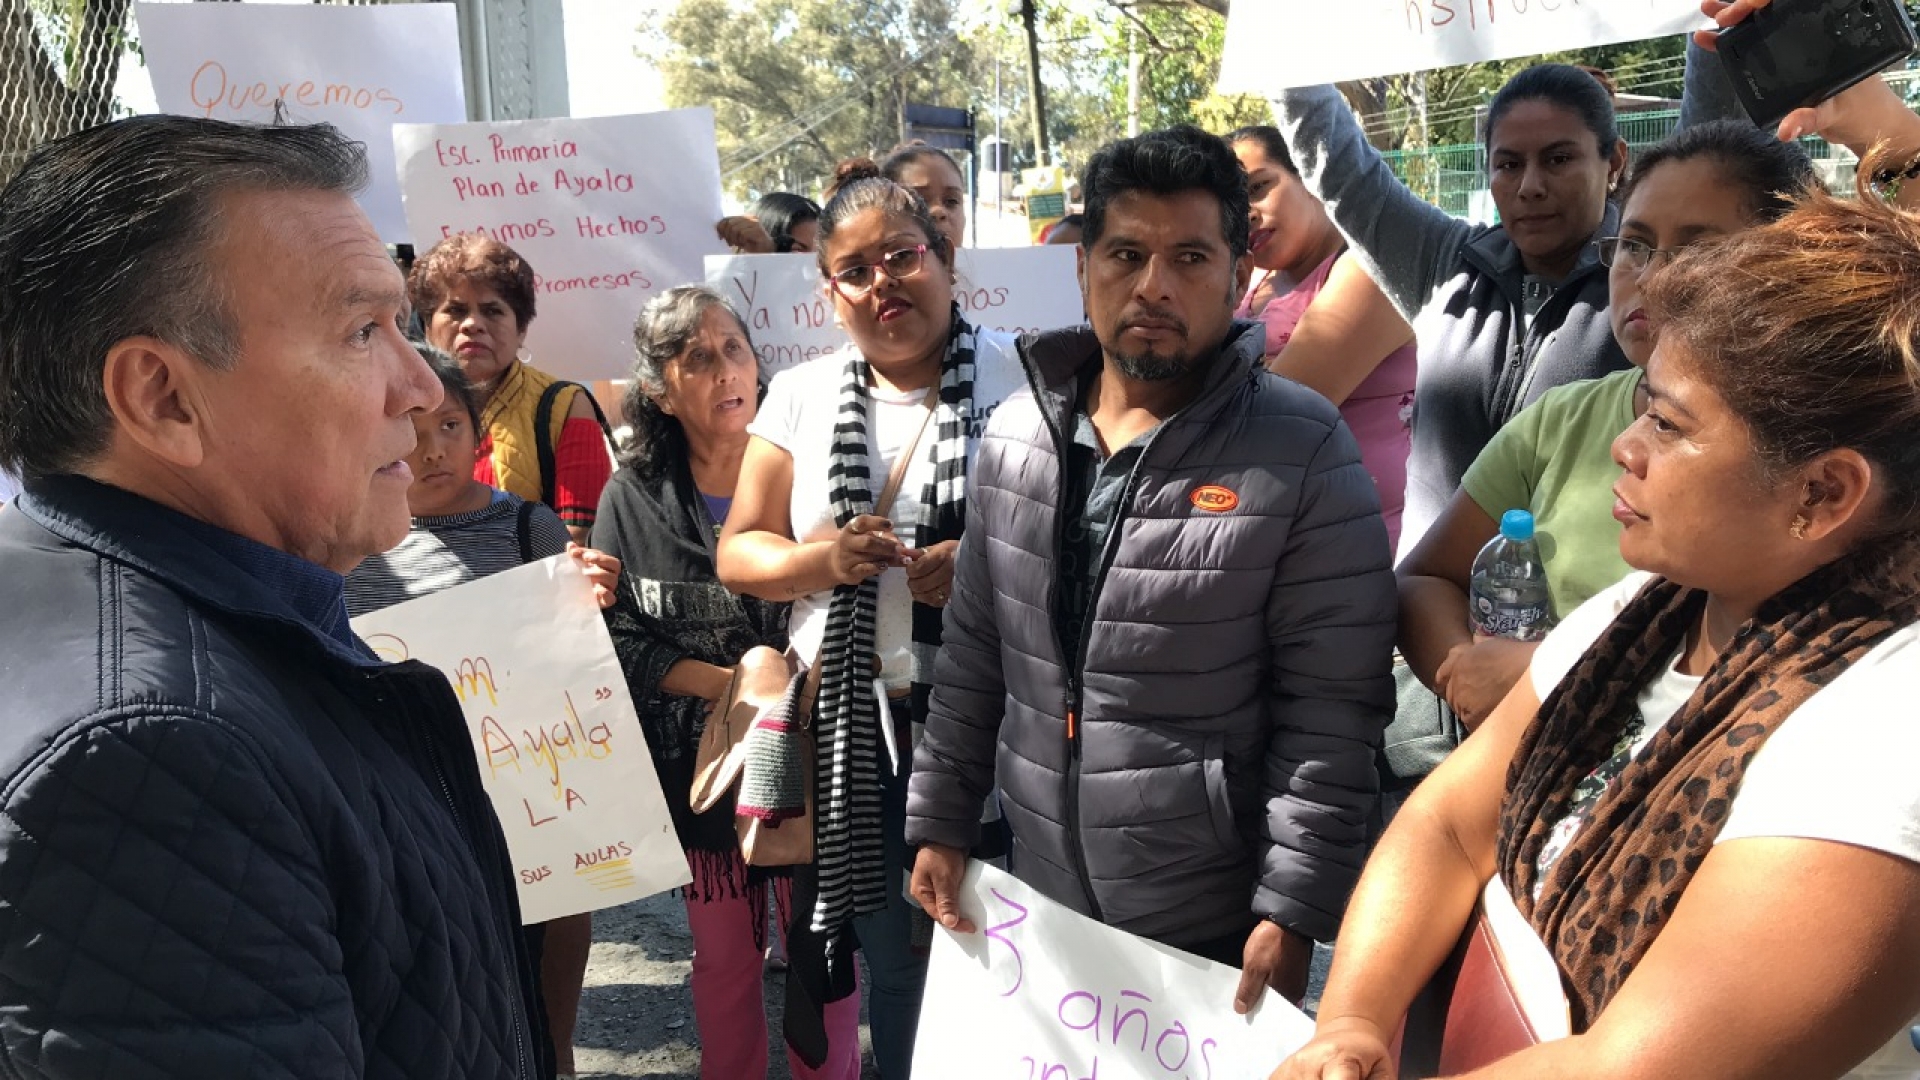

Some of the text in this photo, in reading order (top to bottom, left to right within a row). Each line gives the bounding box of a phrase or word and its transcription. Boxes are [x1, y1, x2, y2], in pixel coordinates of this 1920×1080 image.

[191, 60, 403, 119] Queremos
[435, 133, 578, 167] Esc. Primaria
[453, 168, 634, 201] Plan de Ayala
[576, 215, 666, 239] Hechos
[733, 270, 770, 329] Ya
[792, 301, 825, 329] no
[574, 841, 633, 870] AULAS
[984, 887, 1218, 1080] 3 años
